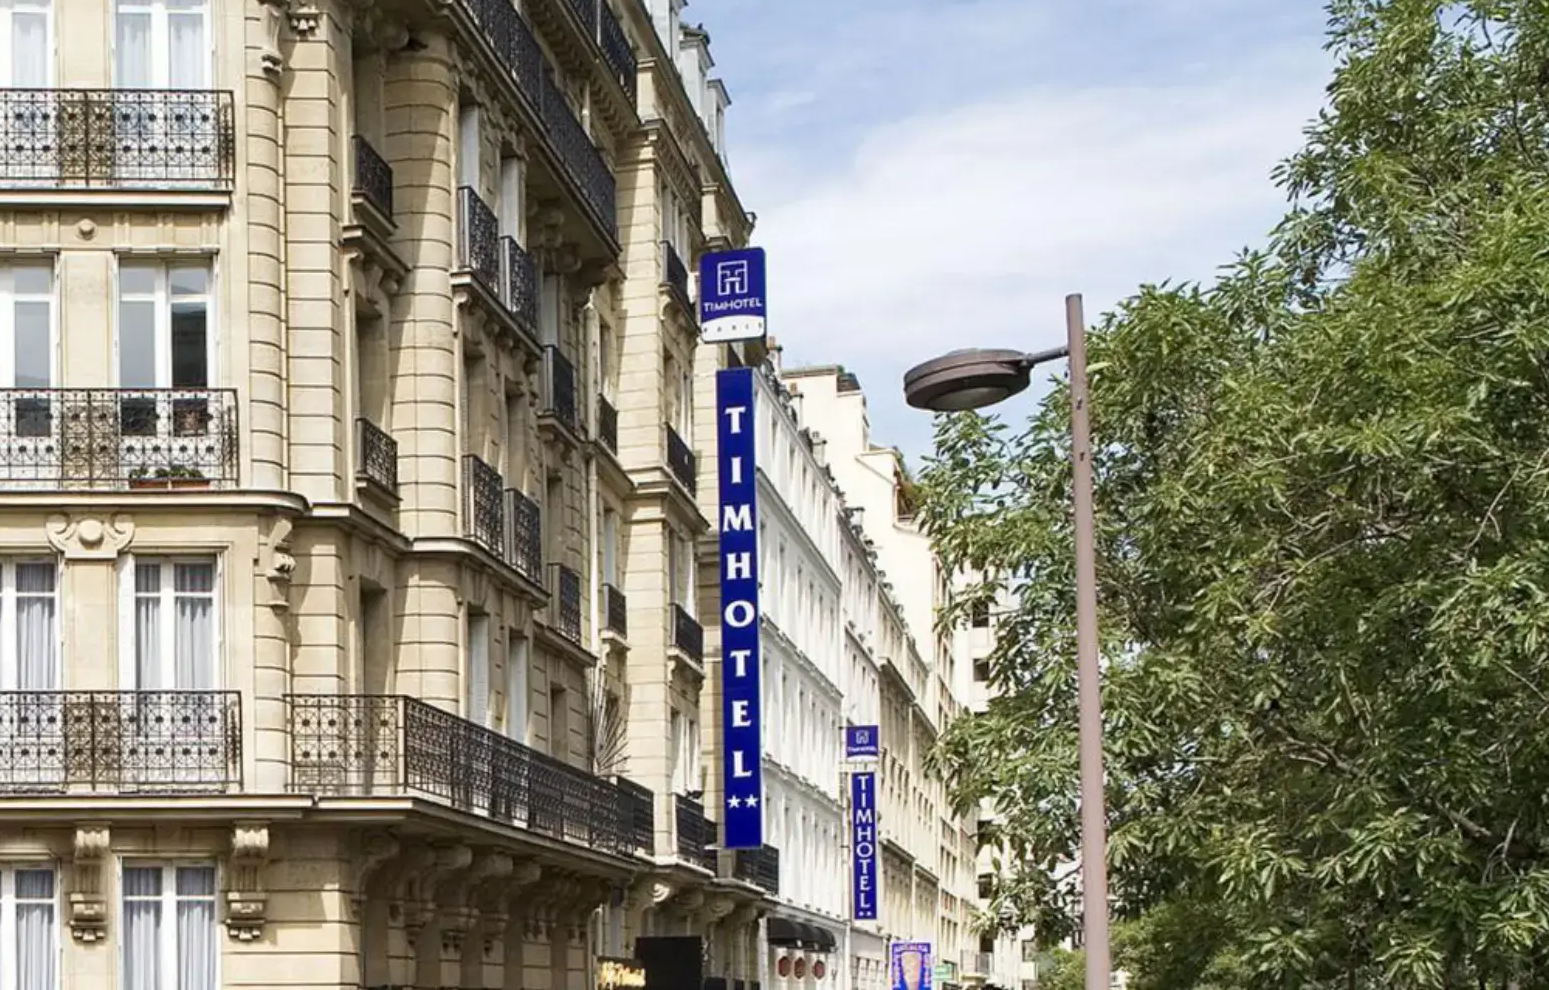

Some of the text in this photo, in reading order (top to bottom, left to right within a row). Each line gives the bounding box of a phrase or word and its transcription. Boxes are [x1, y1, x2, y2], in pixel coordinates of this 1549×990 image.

[704, 297, 763, 312] TIMHOTEL
[722, 406, 755, 778] TIMHOTEL
[855, 775, 874, 909] TIMHOTEL
